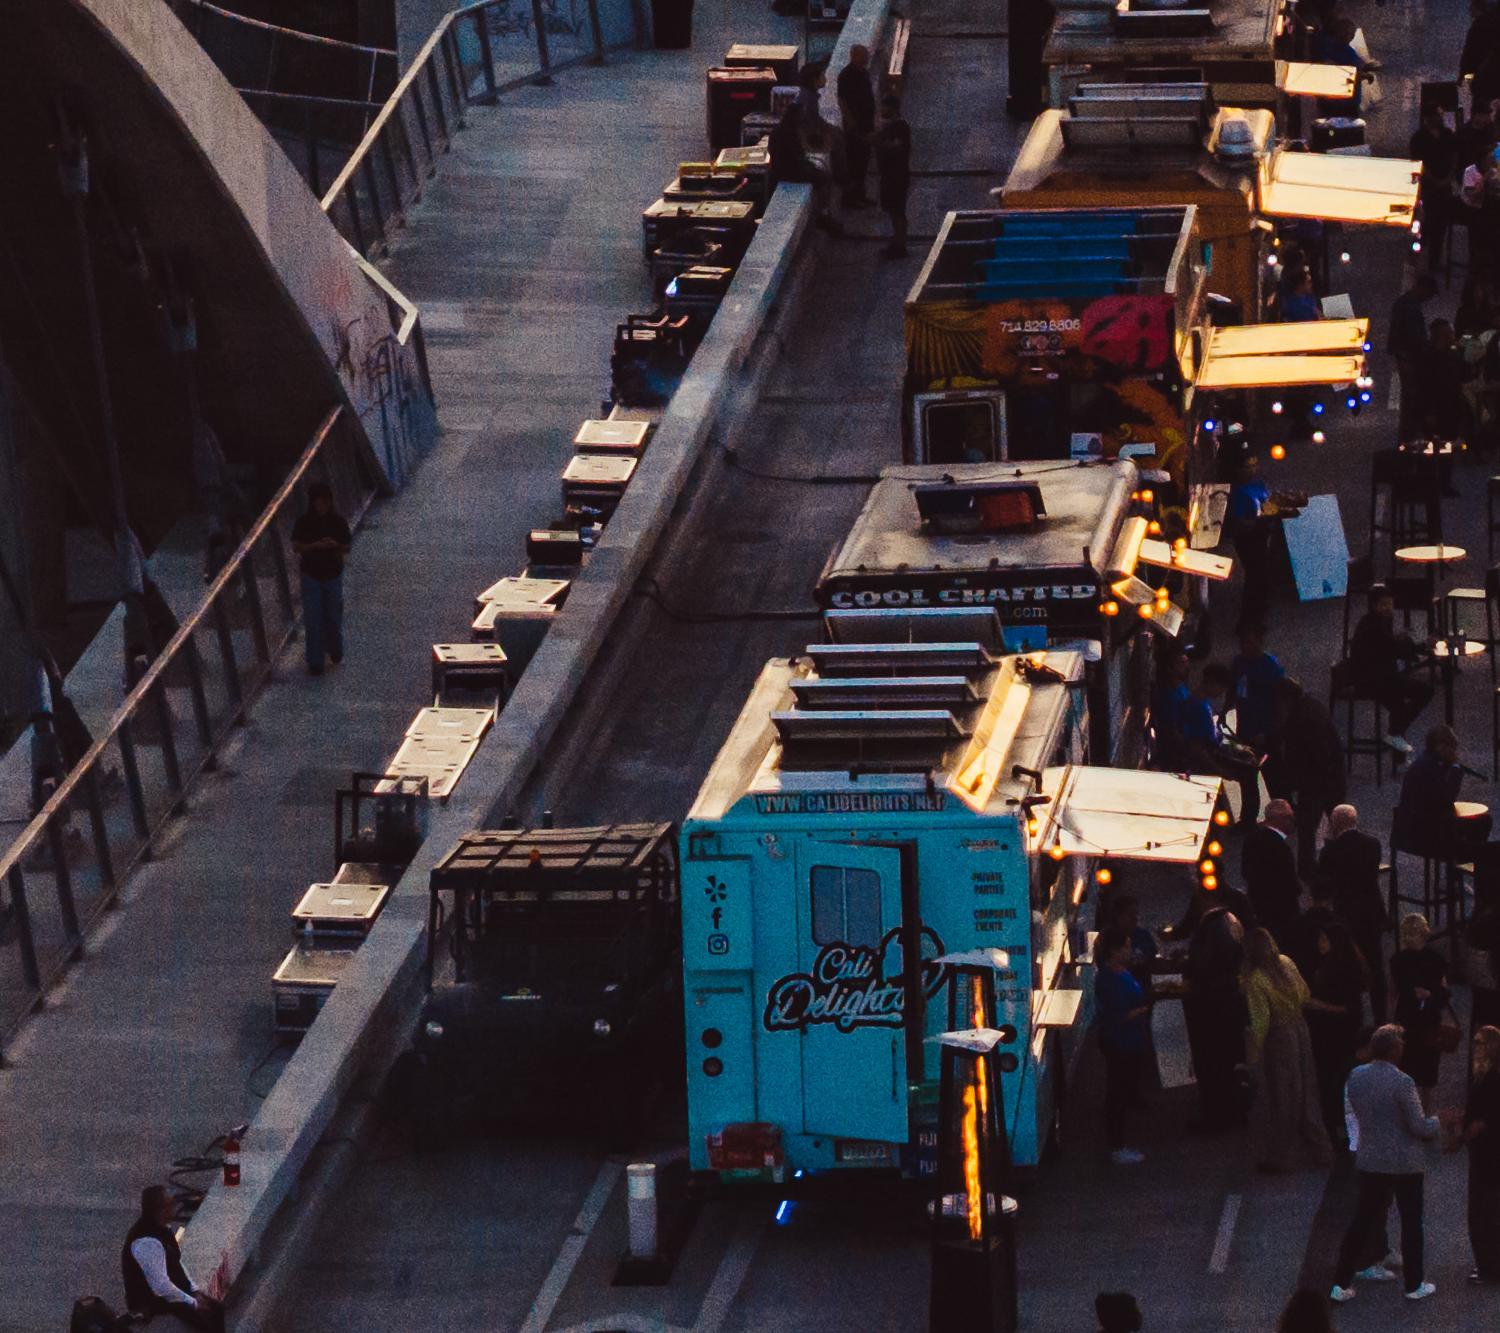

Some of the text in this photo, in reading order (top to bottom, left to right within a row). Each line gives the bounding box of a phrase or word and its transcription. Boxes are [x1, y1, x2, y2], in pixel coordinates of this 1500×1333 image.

[831, 584, 1097, 608] COOL CRAFTED
[819, 947, 873, 984] Cali
